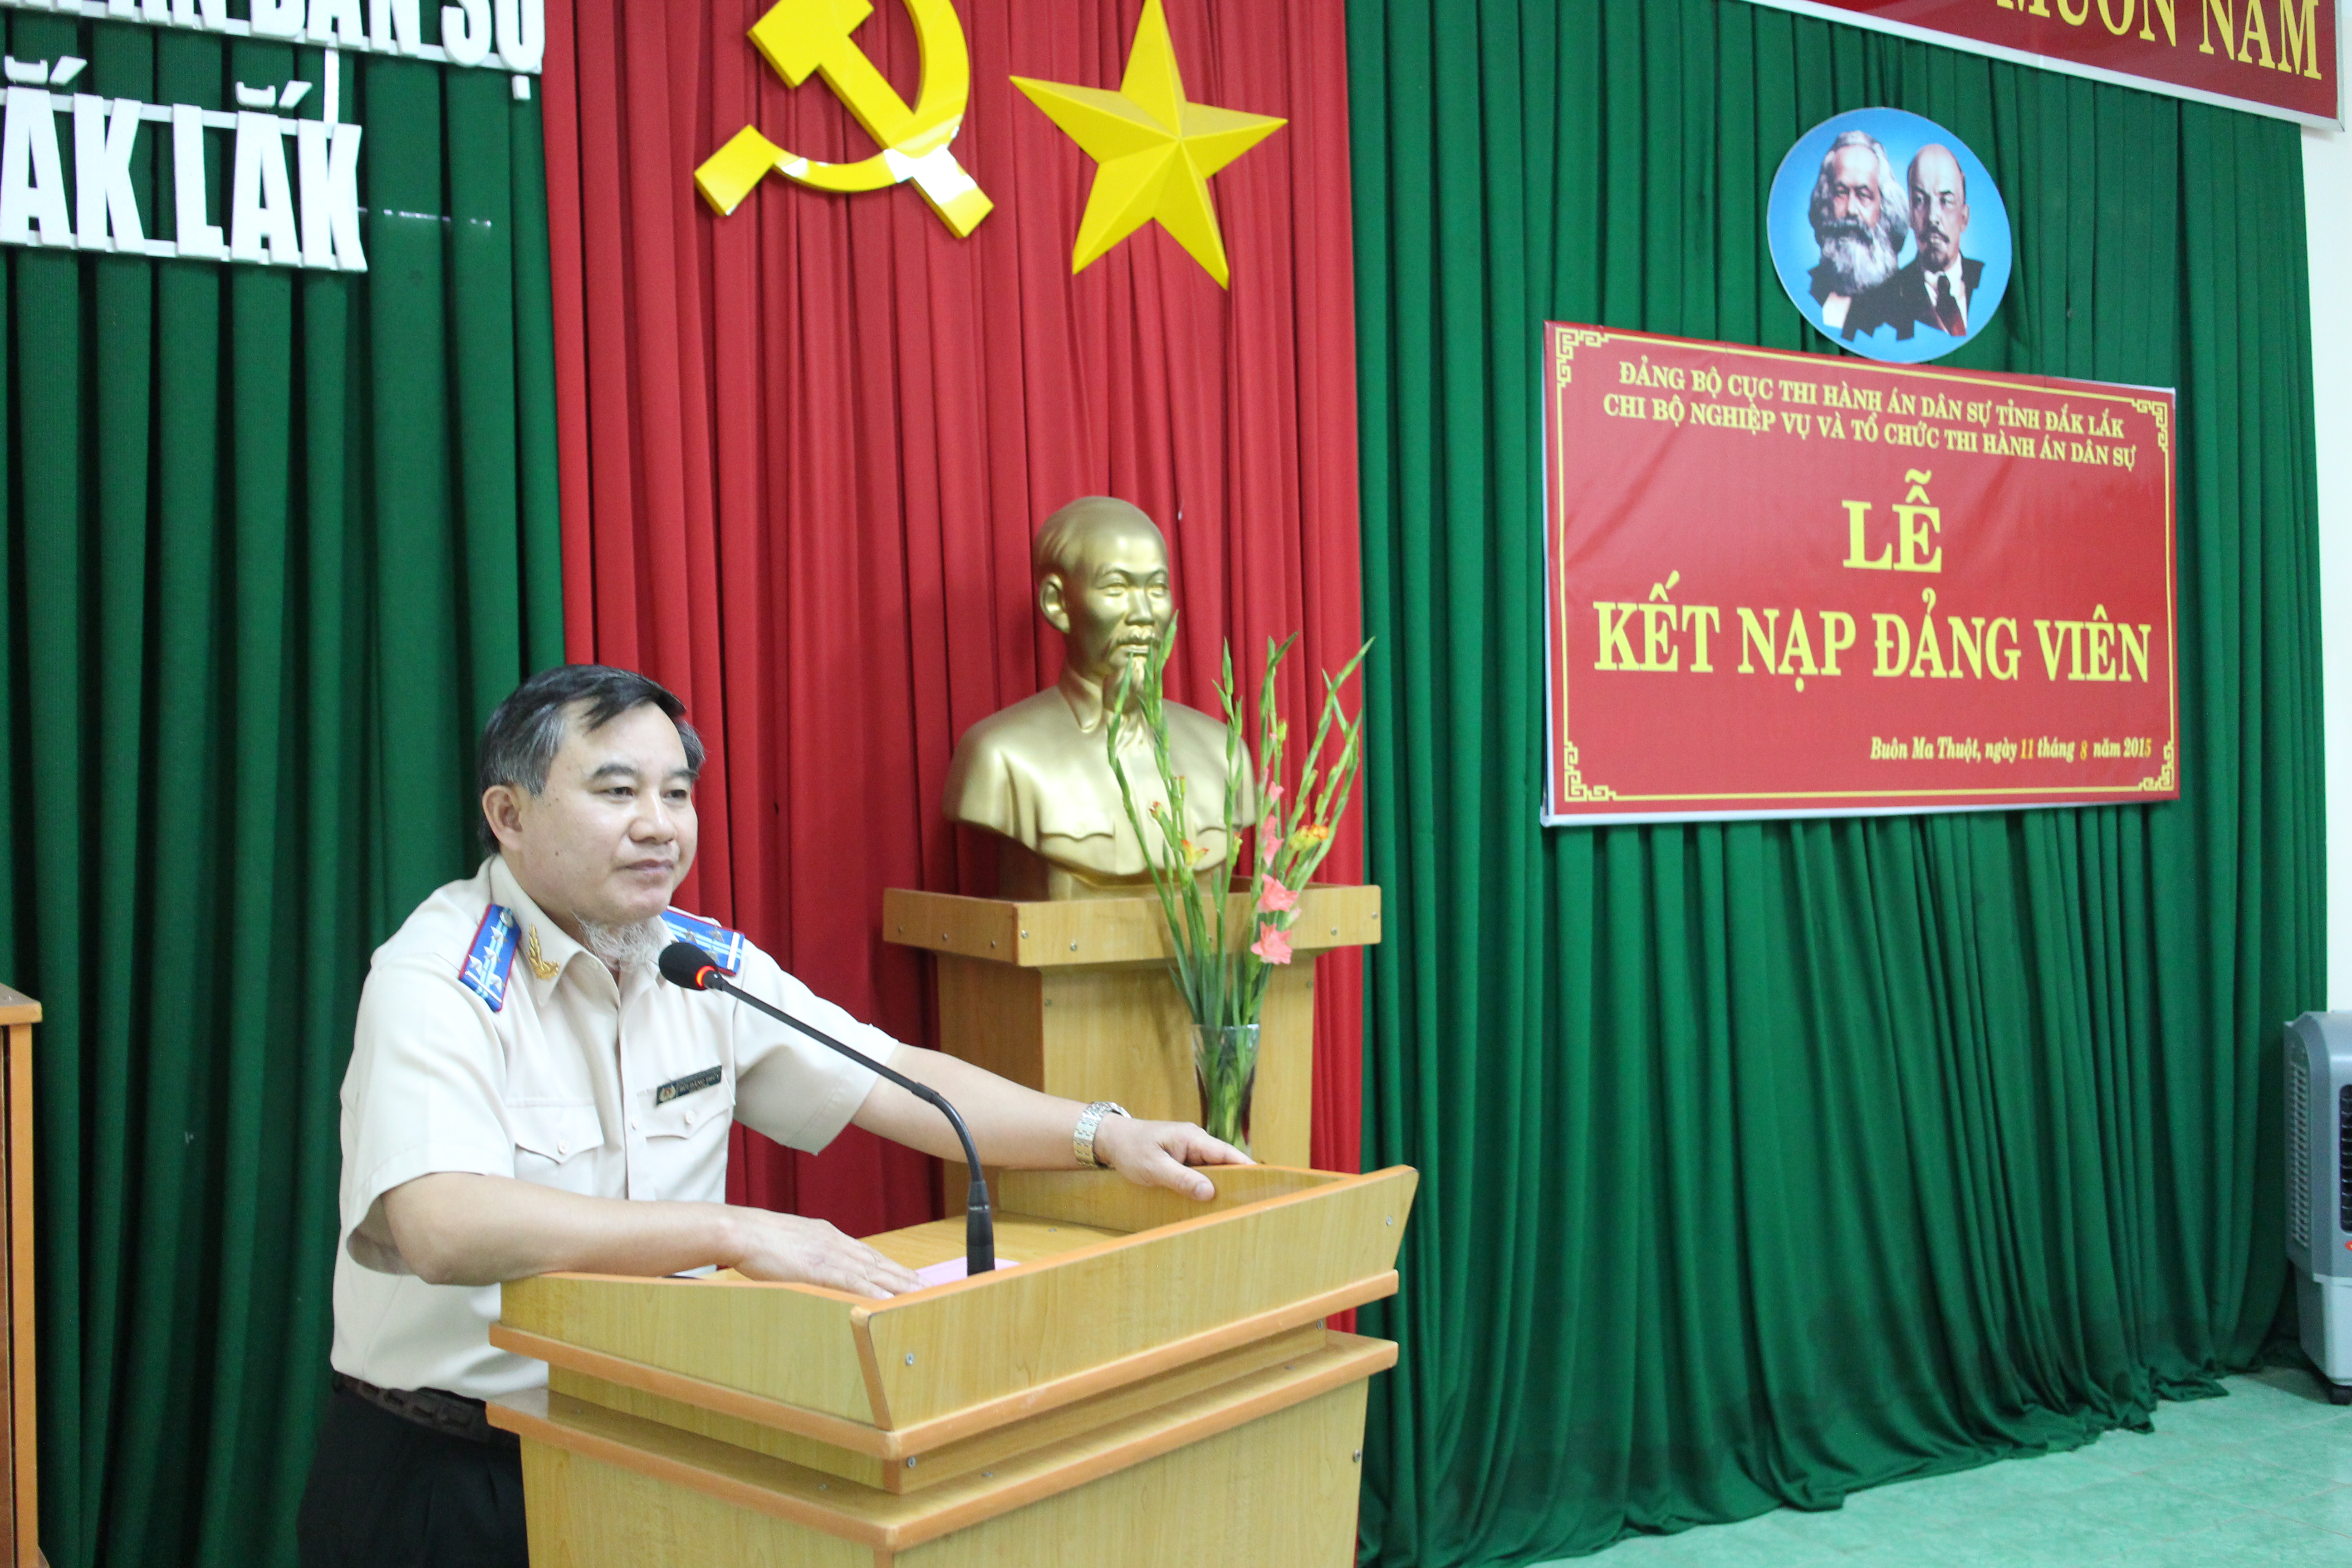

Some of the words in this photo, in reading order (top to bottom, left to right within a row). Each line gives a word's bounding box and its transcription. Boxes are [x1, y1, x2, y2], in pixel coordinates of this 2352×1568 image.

[172, 80, 368, 272] LẮK
[1603, 393, 1646, 419] CHI
[1651, 394, 1685, 427] BỘ
[1690, 402, 1776, 435] NGHIỆP
[1781, 412, 1811, 440] VỤ
[1817, 411, 1846, 441] VÀ
[1884, 420, 1940, 449] CHỨC
[1944, 429, 1978, 453] THI
[1983, 429, 2035, 459] HÀNH
[2040, 434, 2066, 461] ÁN
[2071, 439, 2108, 465] DÂN
[2112, 444, 2136, 471] SỰ
[1619, 355, 1686, 390] ĐẢNG
[1691, 366, 1722, 399] BỘ
[1727, 375, 1774, 402] CỤC
[1779, 380, 1817, 405] THI
[1823, 381, 1882, 412] HÀNH
[1887, 387, 1916, 416] ÁN
[1921, 392, 1962, 421] DÂN
[1967, 400, 1992, 427] SỰ
[1841, 468, 1942, 573] LỄ
[1593, 570, 1720, 672] KẾT
[1737, 608, 1856, 692] NẠP
[1872, 588, 2022, 681] ĐẢNG
[2034, 604, 2151, 682] VIÊN
[1870, 736, 1908, 760] Buôn
[1911, 736, 1934, 760] Ma
[1937, 736, 1981, 764] Thuột,
[1985, 737, 2018, 764] ngày
[2020, 739, 2034, 760] 11
[2037, 736, 2075, 764] tháng
[2080, 740, 2087, 760] 8
[2093, 738, 2121, 758] năm
[2123, 737, 2152, 758] 2015
